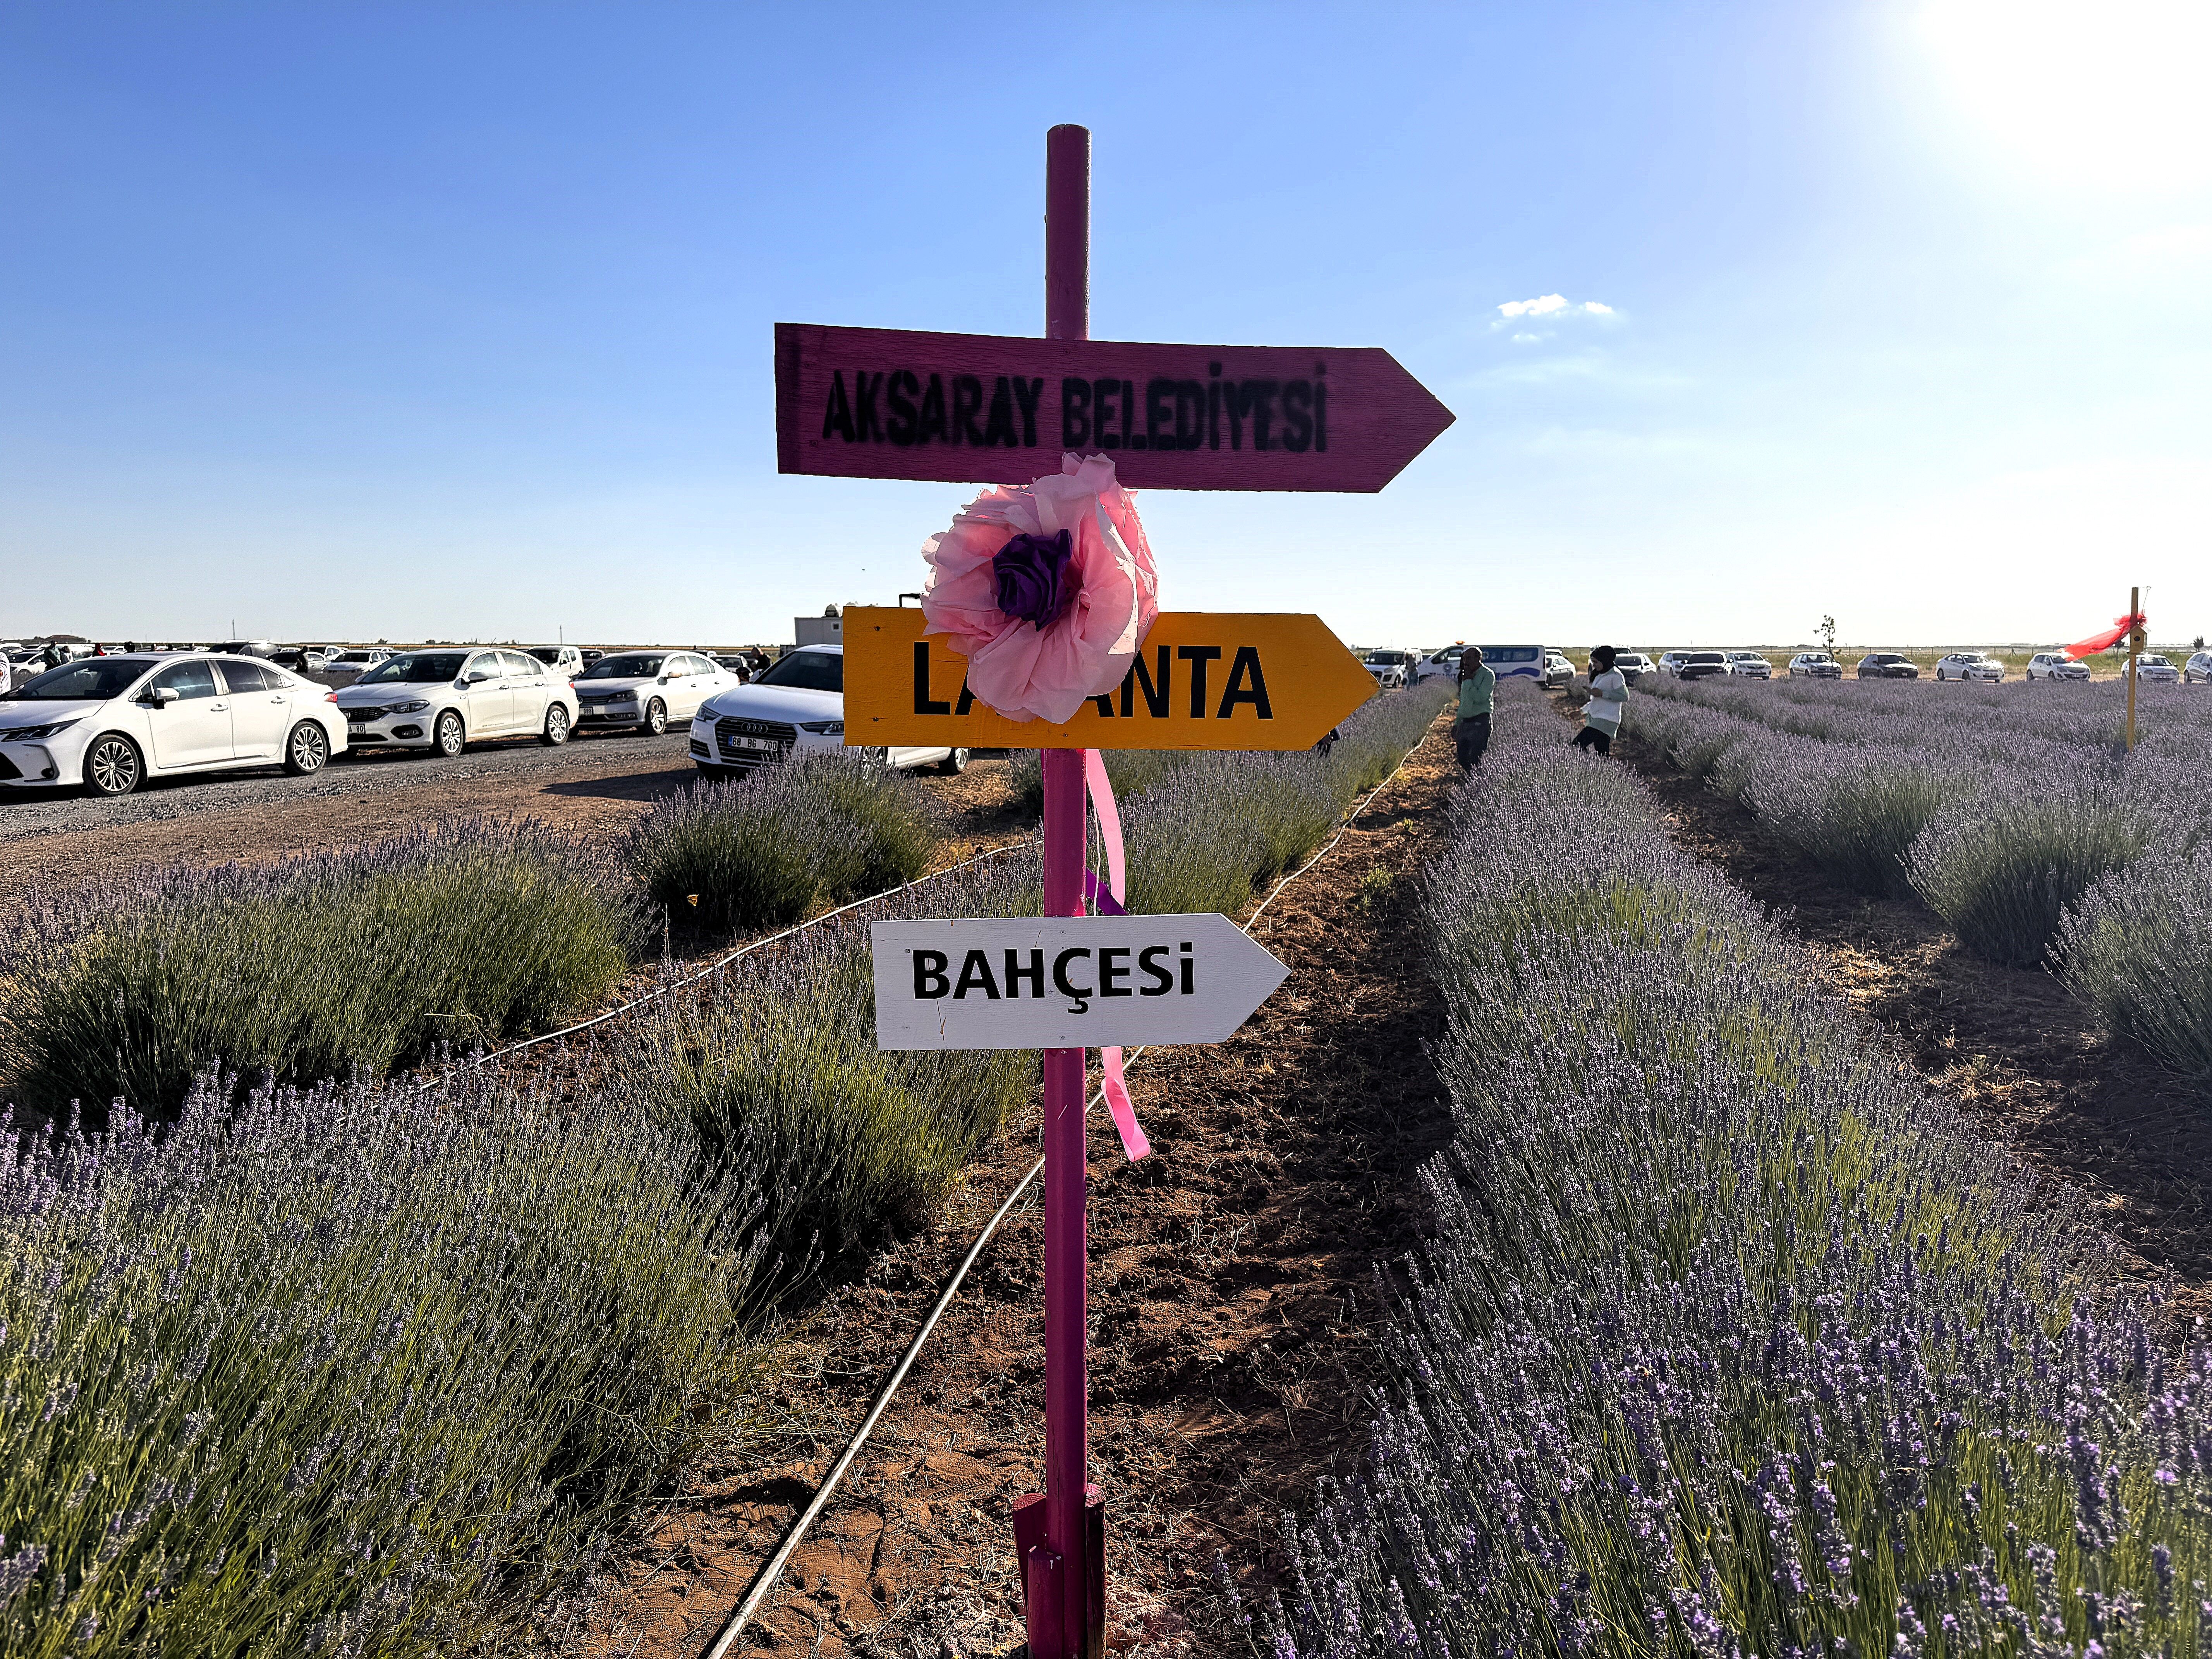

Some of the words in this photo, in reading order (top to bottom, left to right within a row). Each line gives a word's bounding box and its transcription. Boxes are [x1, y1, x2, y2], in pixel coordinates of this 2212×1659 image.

[823, 369, 1043, 448] AKSARAY
[1061, 361, 1328, 452] BELEDİYESİ
[914, 641, 1274, 720] LNTA
[733, 737, 741, 746] 68
[763, 740, 777, 750] 700
